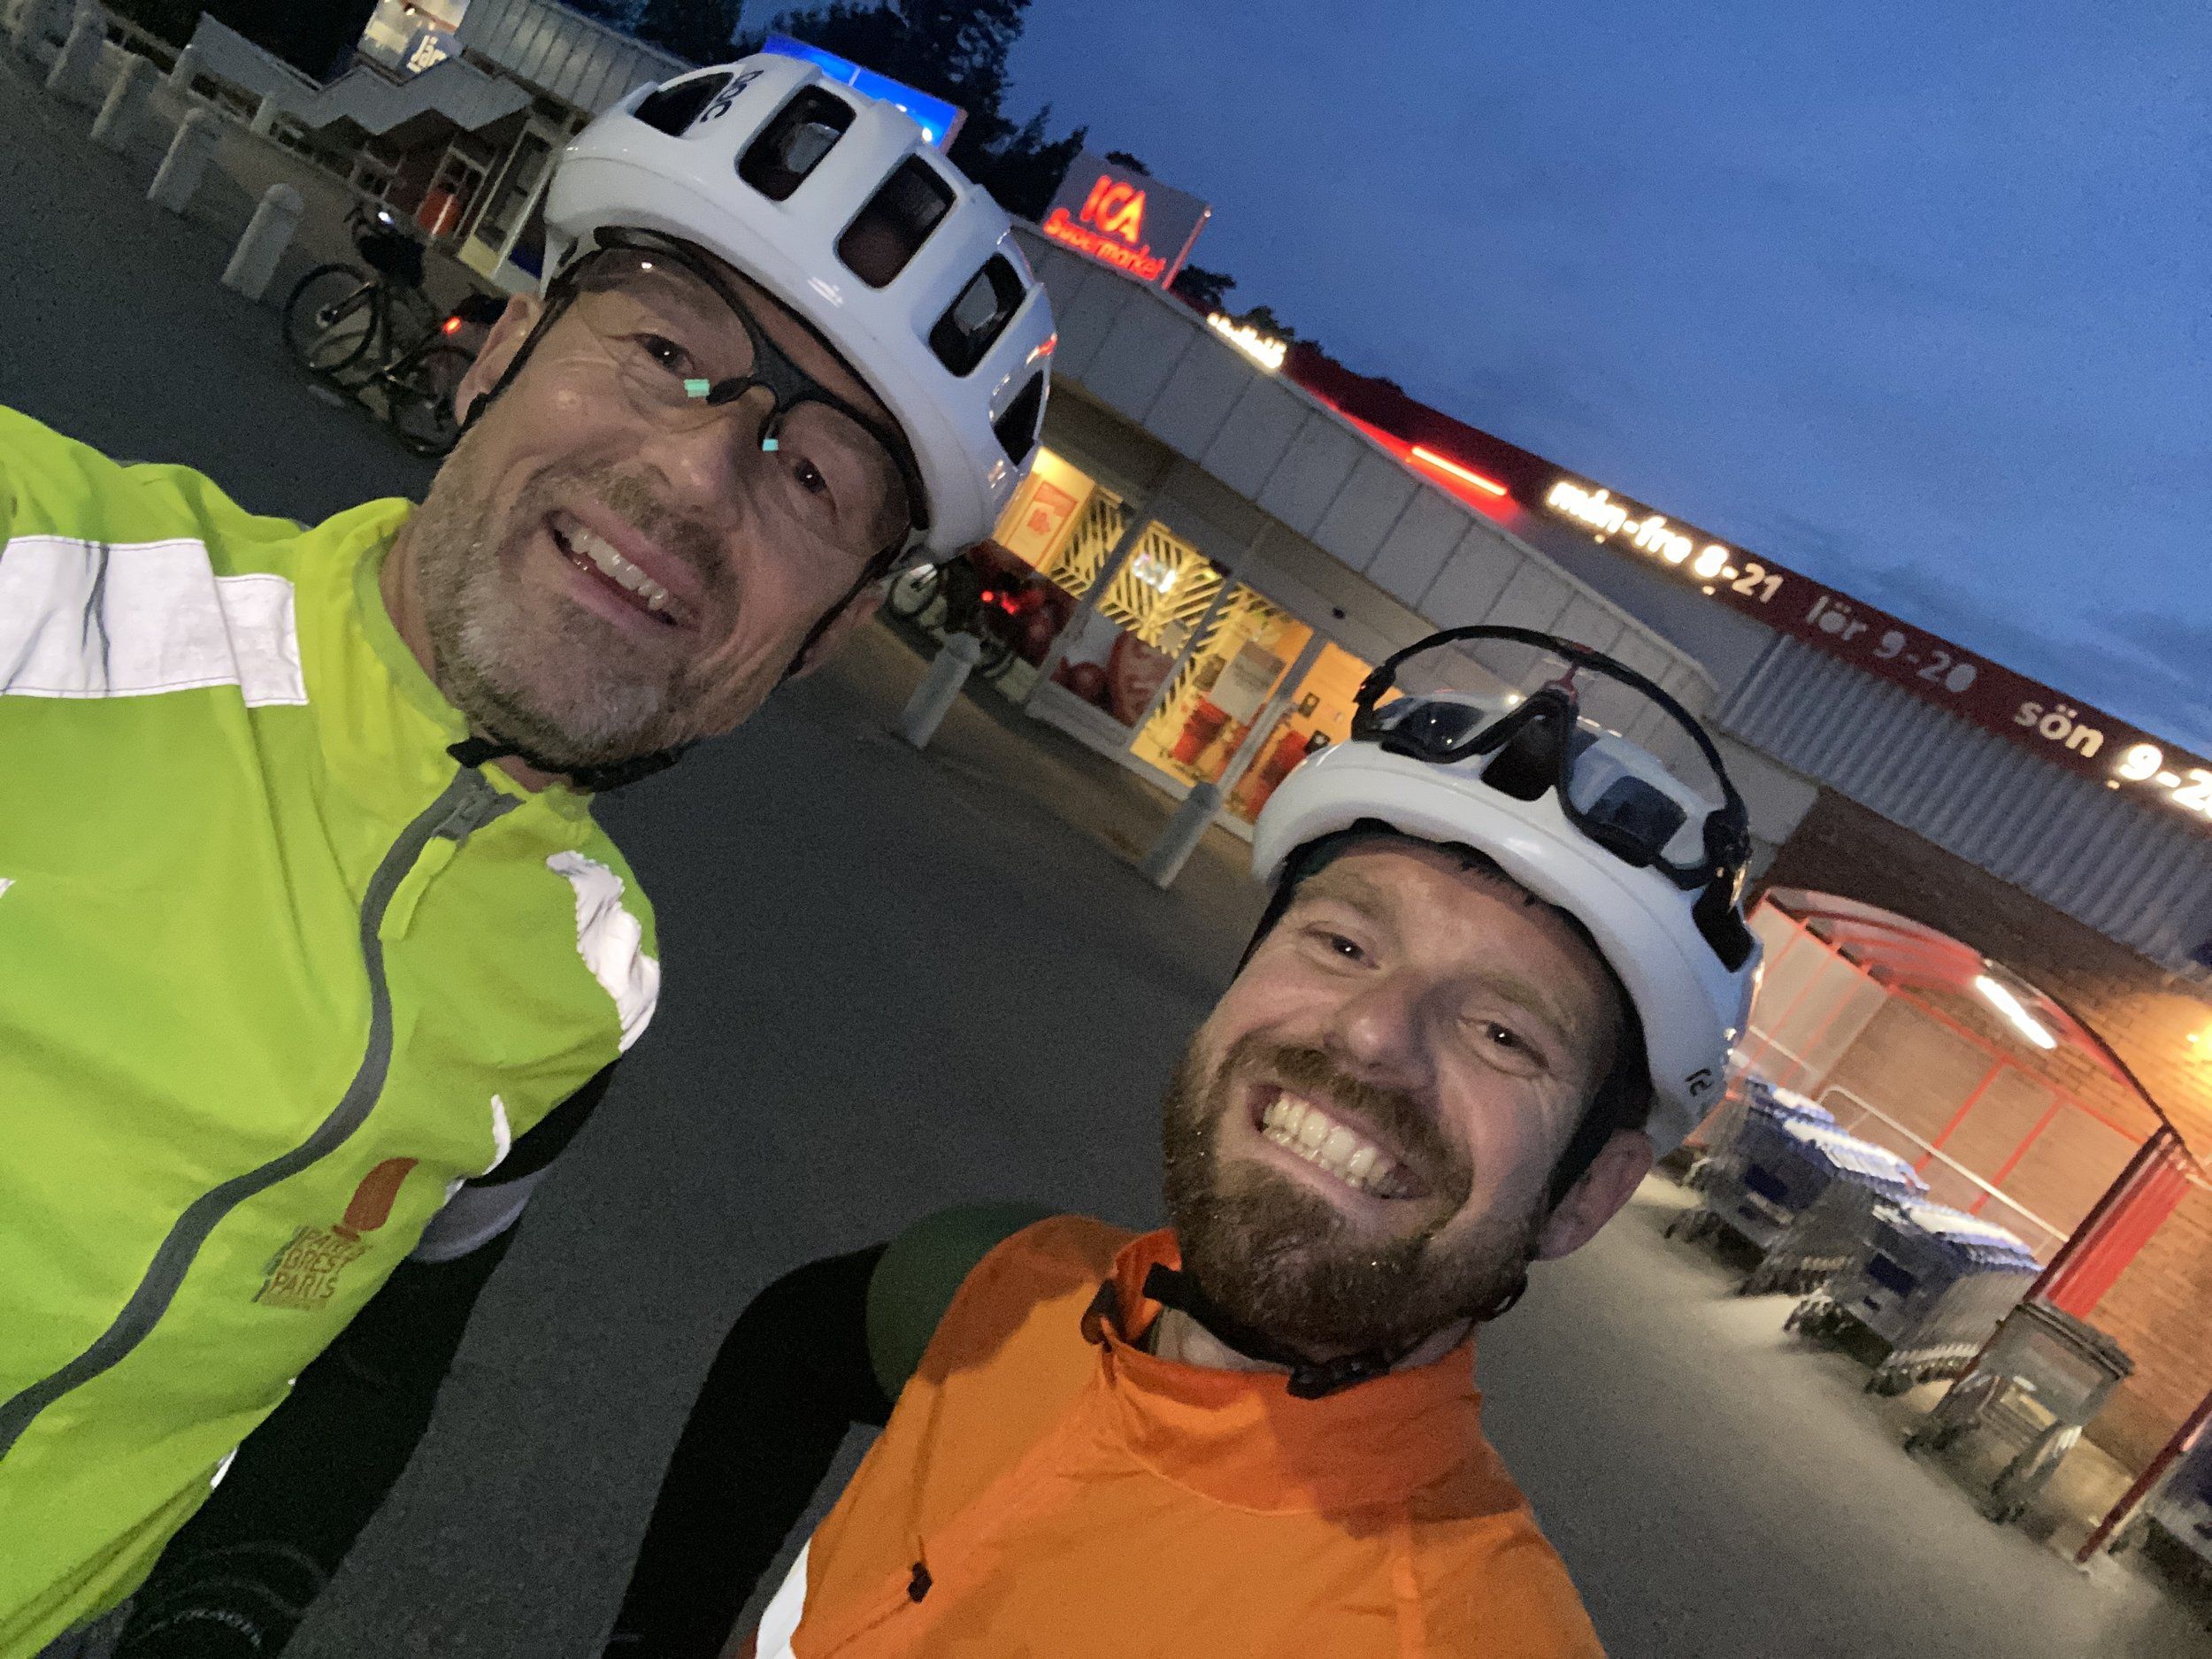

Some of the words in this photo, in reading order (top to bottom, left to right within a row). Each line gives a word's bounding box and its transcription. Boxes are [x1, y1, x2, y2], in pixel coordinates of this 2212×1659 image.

[1079, 174, 1146, 244] ICA
[1805, 595, 1868, 641] lör
[1872, 630, 1978, 693] 9-20
[2014, 701, 2105, 758] sön
[2118, 742, 2212, 820] 9-2
[269, 1271, 338, 1299] PARIS
